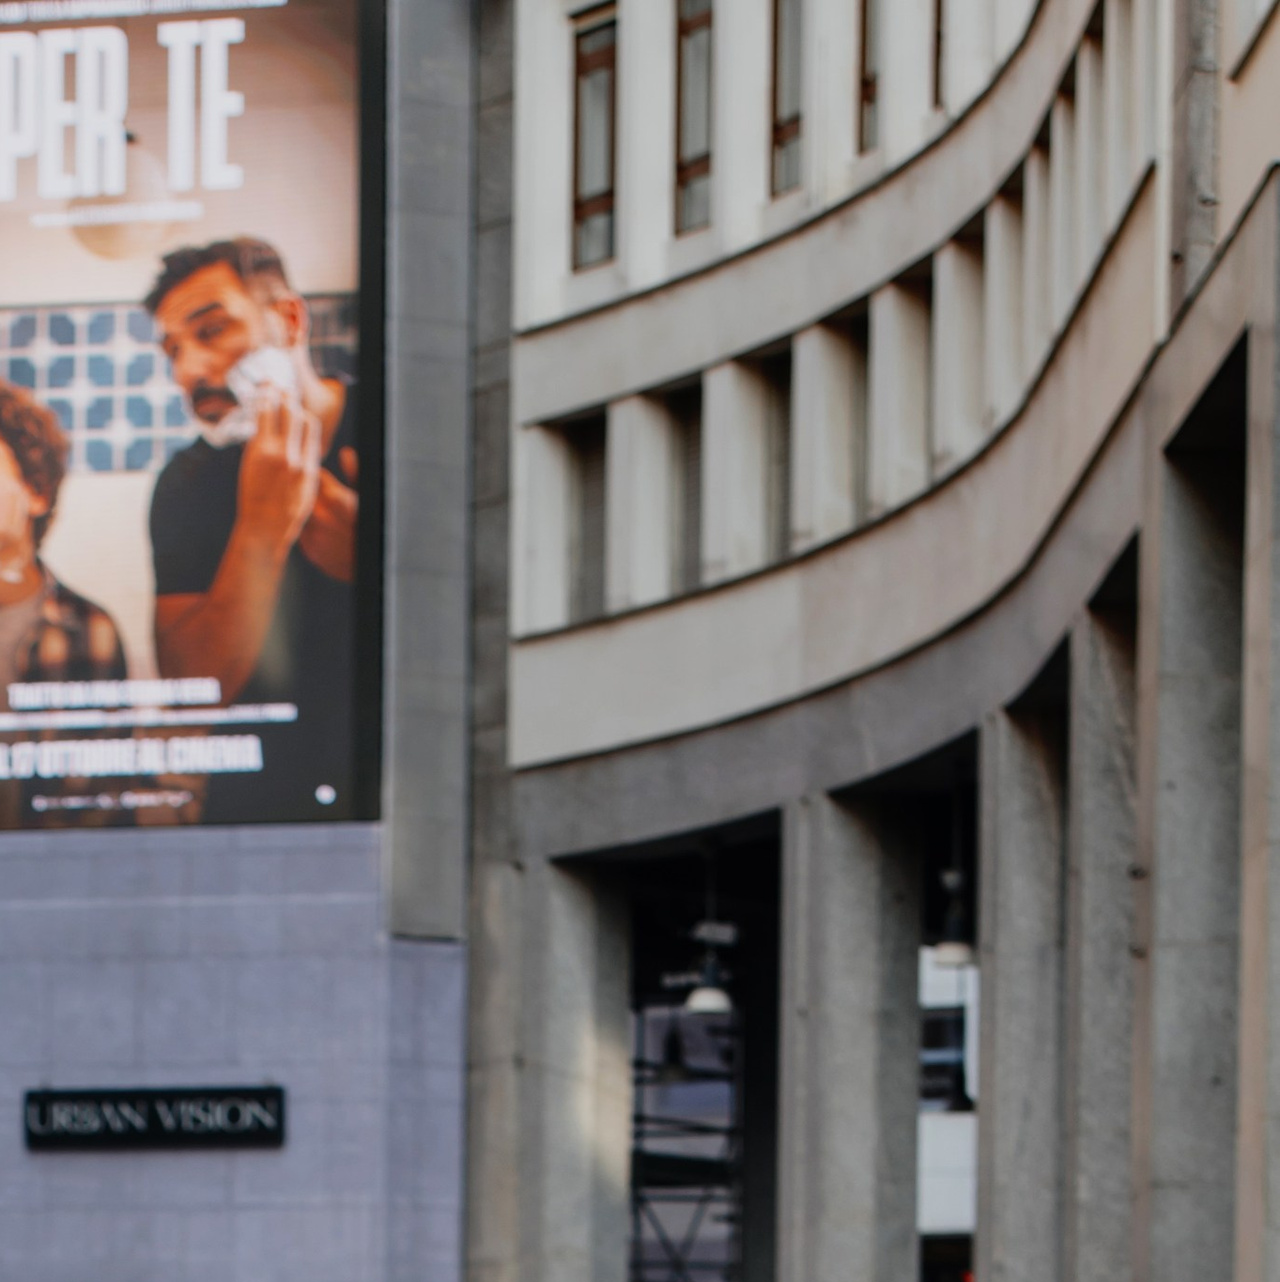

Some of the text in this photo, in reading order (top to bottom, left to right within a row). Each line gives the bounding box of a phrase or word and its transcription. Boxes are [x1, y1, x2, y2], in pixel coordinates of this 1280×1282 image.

[158, 18, 245, 191] TE
[28, 1096, 278, 1135] URBAN VISION
